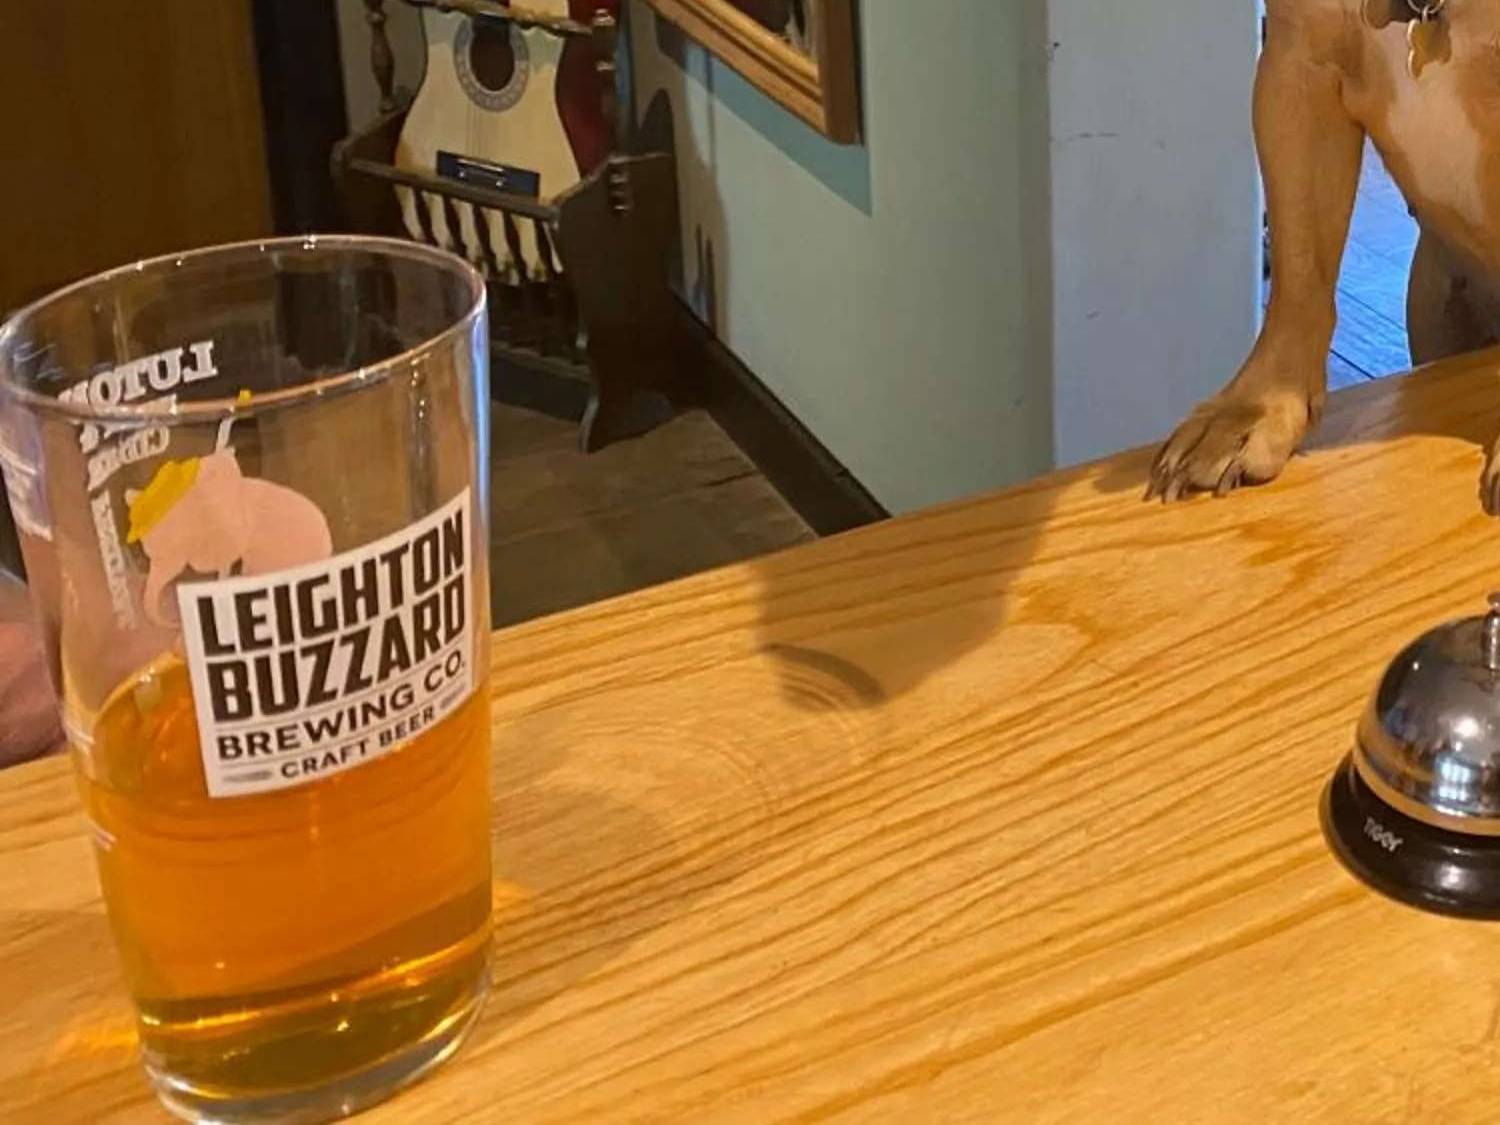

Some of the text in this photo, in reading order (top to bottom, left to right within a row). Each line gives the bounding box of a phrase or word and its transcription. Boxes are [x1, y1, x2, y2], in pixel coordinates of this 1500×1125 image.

[197, 508, 465, 657] LEIGHTON
[206, 573, 466, 723] BUZZARD
[216, 649, 466, 760] BREWING CO.
[280, 705, 436, 778] CRAFT BEER
